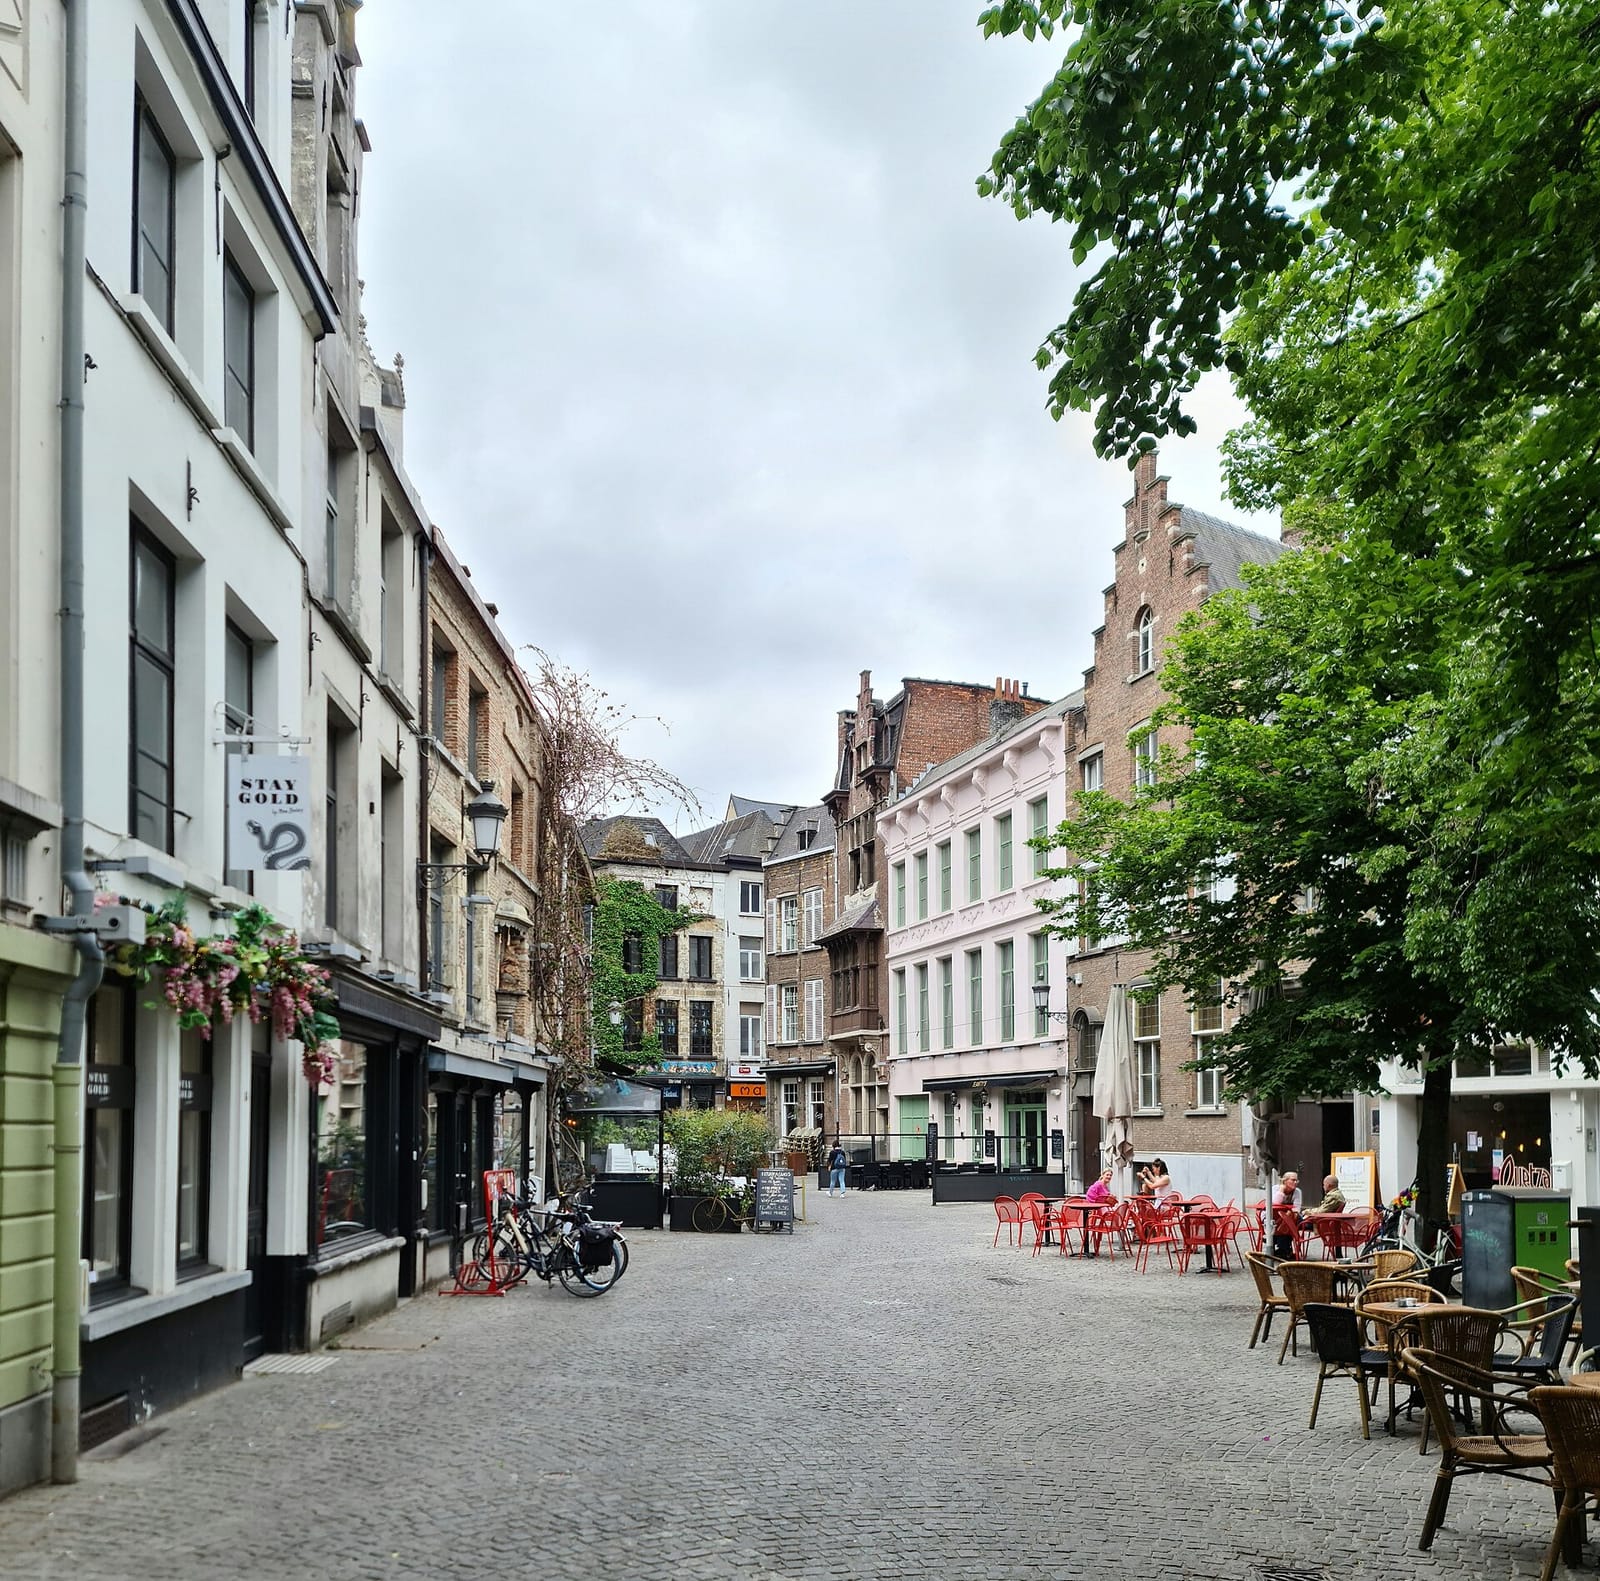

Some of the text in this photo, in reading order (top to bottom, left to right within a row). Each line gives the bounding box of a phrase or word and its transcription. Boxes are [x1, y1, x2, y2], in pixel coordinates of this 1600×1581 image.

[240, 778, 297, 791] STAY
[238, 792, 299, 805] GOLD
[88, 1071, 109, 1083] STAY
[87, 1083, 110, 1095] GOLD
